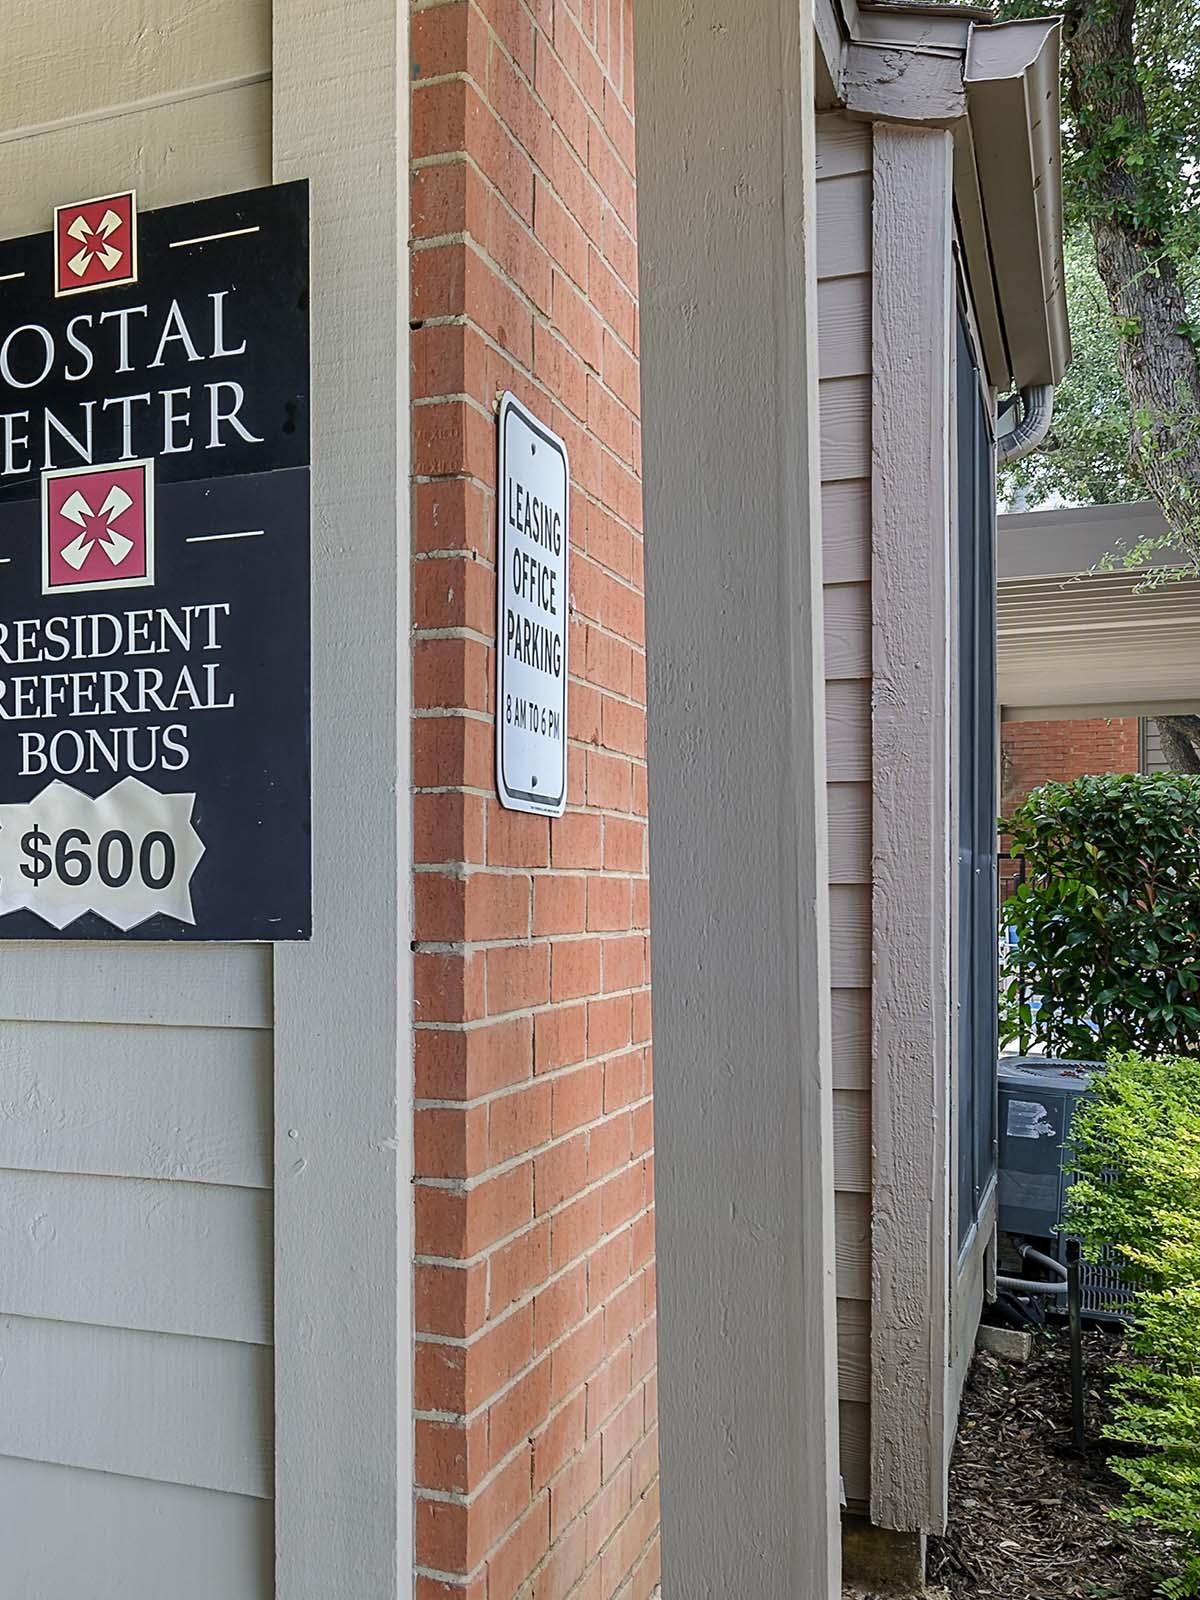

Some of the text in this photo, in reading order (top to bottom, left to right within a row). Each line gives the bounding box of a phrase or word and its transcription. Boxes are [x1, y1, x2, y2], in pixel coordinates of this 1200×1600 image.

[508, 477, 561, 557] LEASING
[513, 547, 557, 615] OFFICE
[507, 608, 561, 678] PARKING
[18, 724, 189, 776] BONUS
[506, 694, 560, 740] 8 AM TO 6 PM
[19, 824, 176, 890] $600
